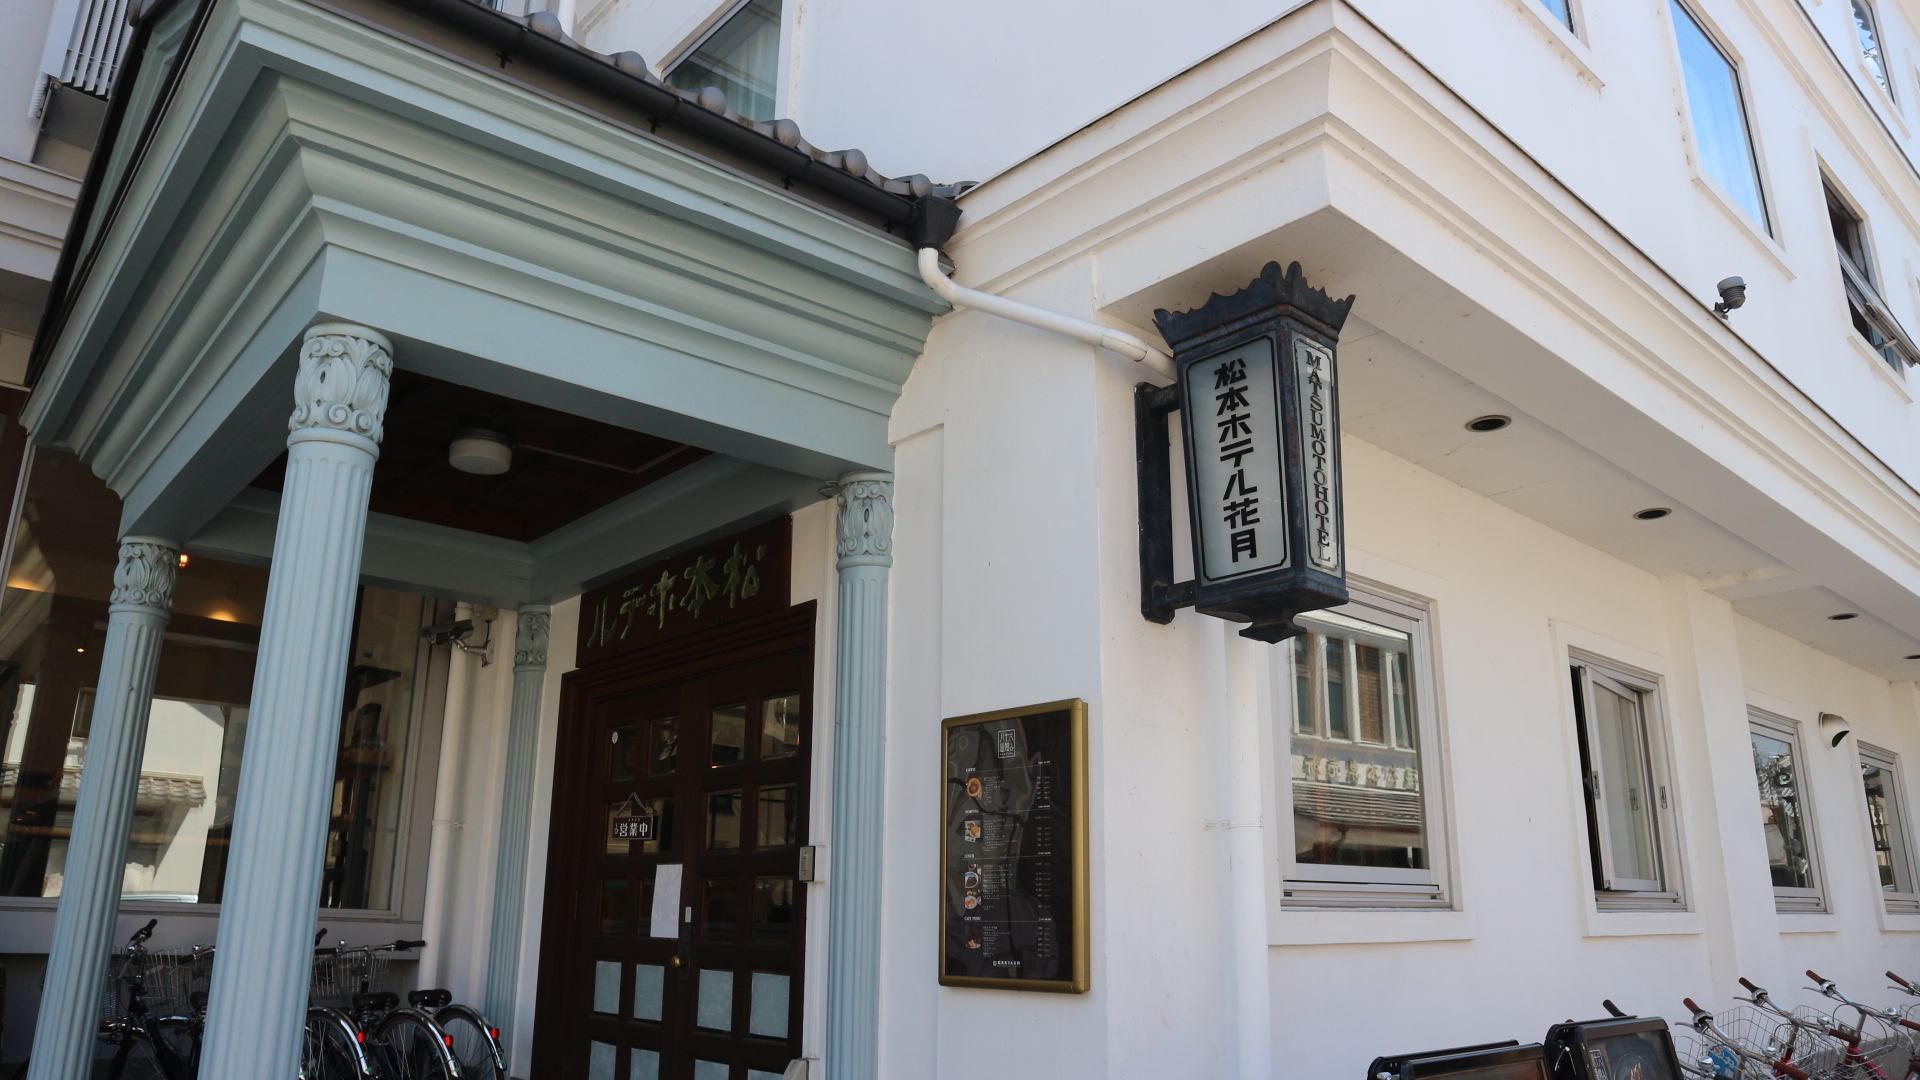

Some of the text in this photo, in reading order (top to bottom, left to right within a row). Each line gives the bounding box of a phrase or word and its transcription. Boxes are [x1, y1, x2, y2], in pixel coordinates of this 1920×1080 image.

[1213, 357, 1260, 563] 松本ホテル花月
[619, 822, 648, 837] 営業中
